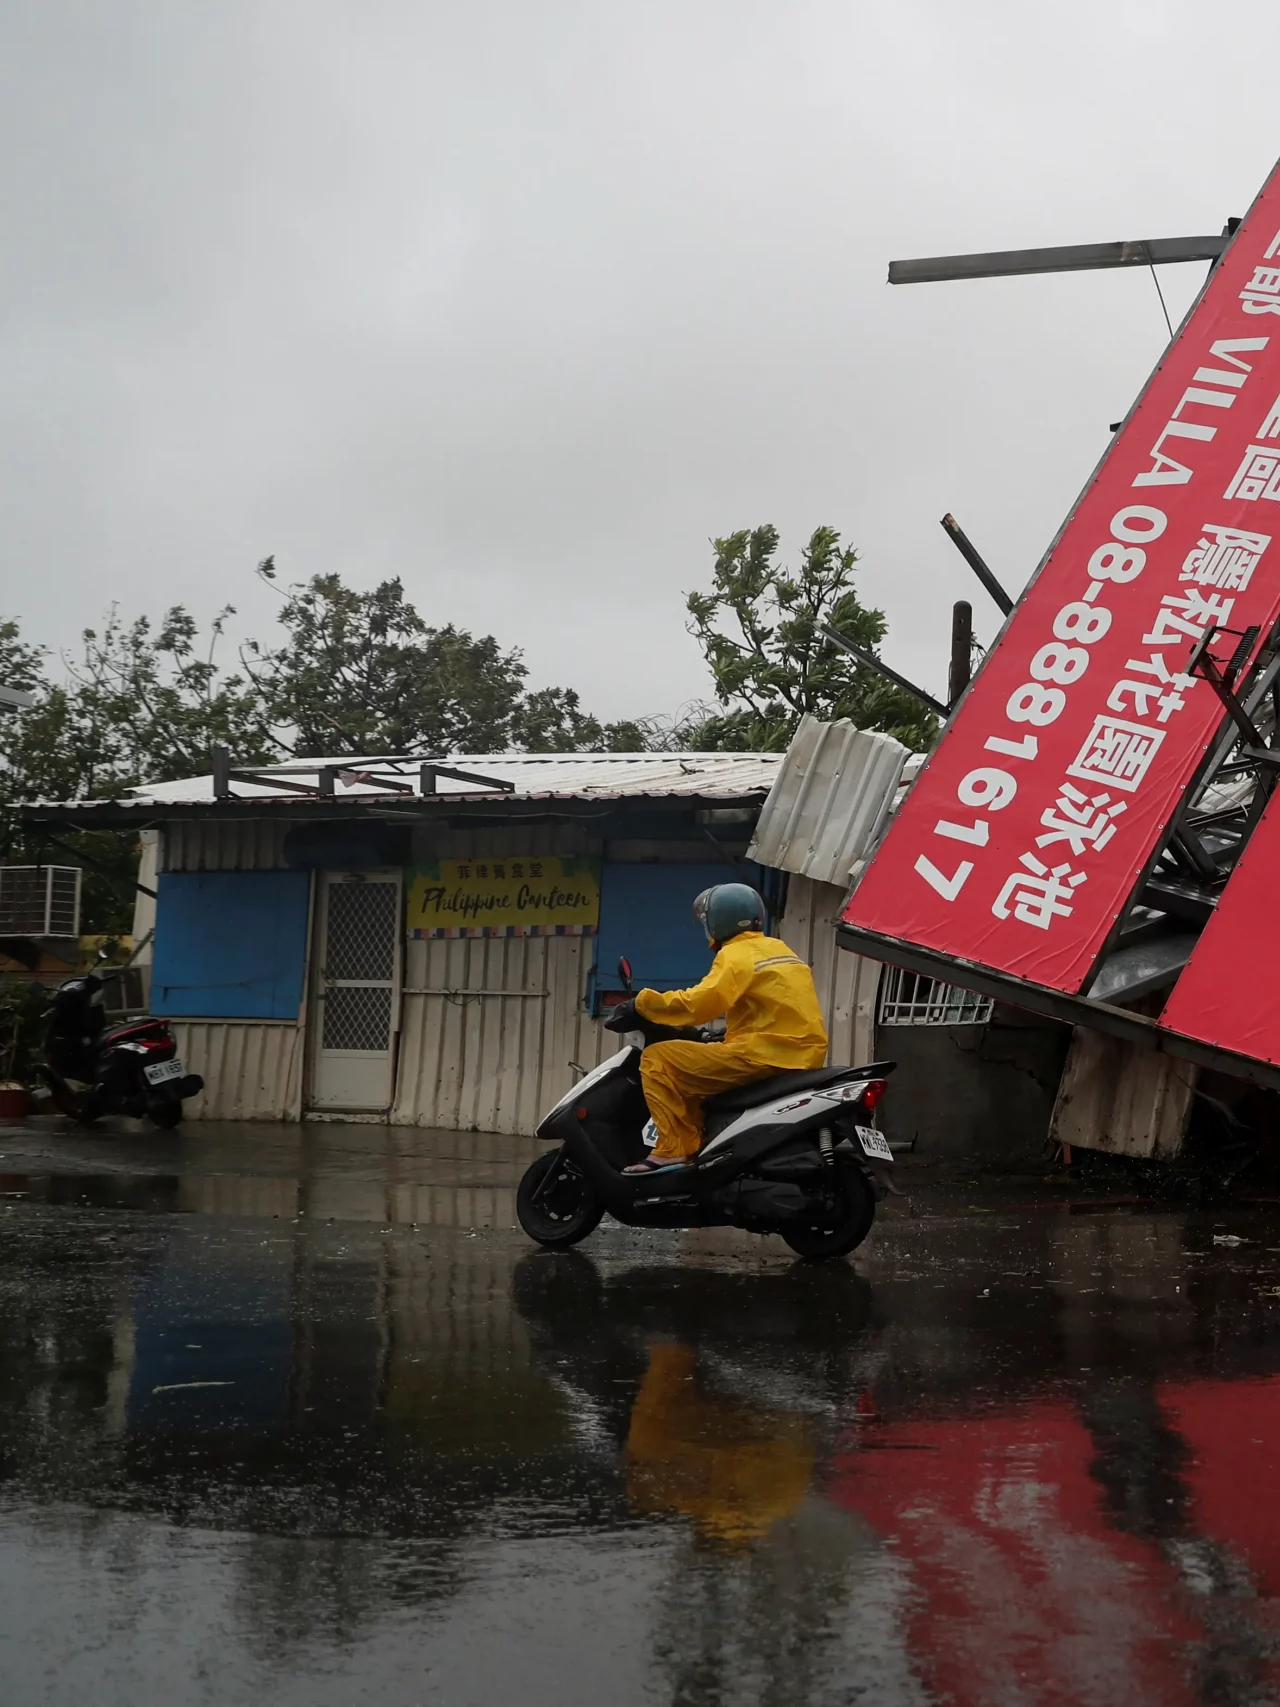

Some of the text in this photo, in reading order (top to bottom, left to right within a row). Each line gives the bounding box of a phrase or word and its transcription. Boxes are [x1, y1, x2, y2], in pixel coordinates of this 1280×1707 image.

[1131, 336, 1271, 488] VILLA
[914, 505, 1169, 903] 08-8881617
[991, 523, 1273, 931] 隱私花園泳池
[421, 884, 590, 919] Philippine Canteen
[457, 862, 543, 880] 菲律賓食堂
